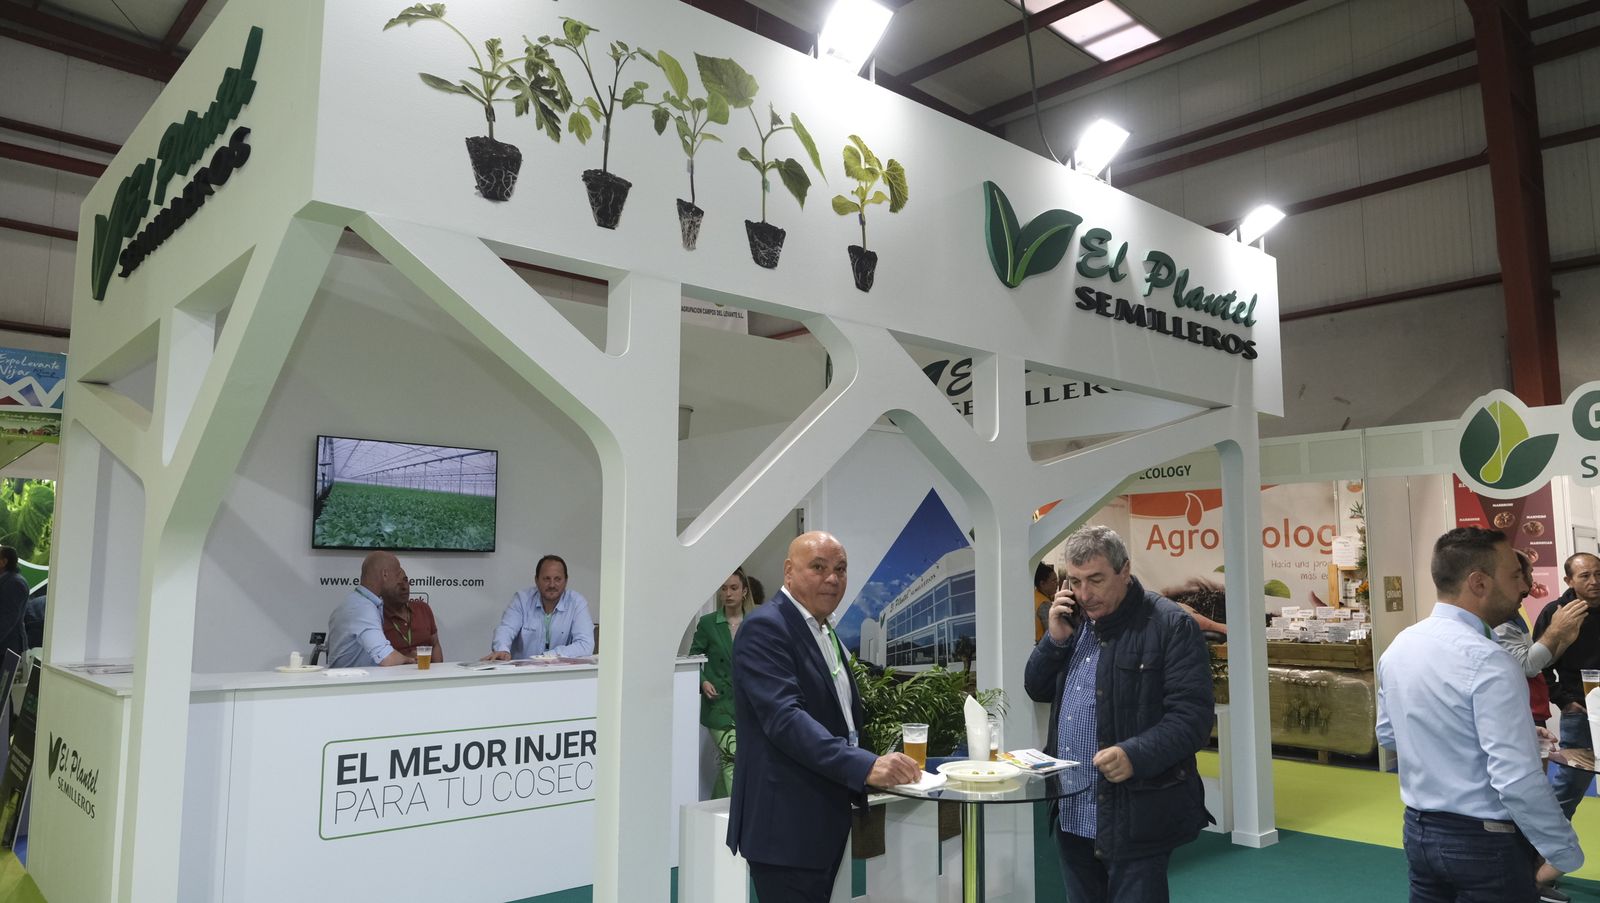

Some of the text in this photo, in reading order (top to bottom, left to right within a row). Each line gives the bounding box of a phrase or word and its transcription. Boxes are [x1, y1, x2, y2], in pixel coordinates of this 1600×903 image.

[1076, 227, 1258, 328] El Plantel
[1074, 286, 1259, 361] SEMILLEROS
[1139, 465, 1191, 480] COLOGY
[320, 576, 484, 587] www.eemilleros.com
[59, 742, 70, 772] El
[69, 749, 99, 795] Plantel
[336, 729, 597, 786] EL MEJOR INJER
[57, 776, 96, 819] SEMILLEROS
[334, 761, 594, 825] PARA TU COSEC
